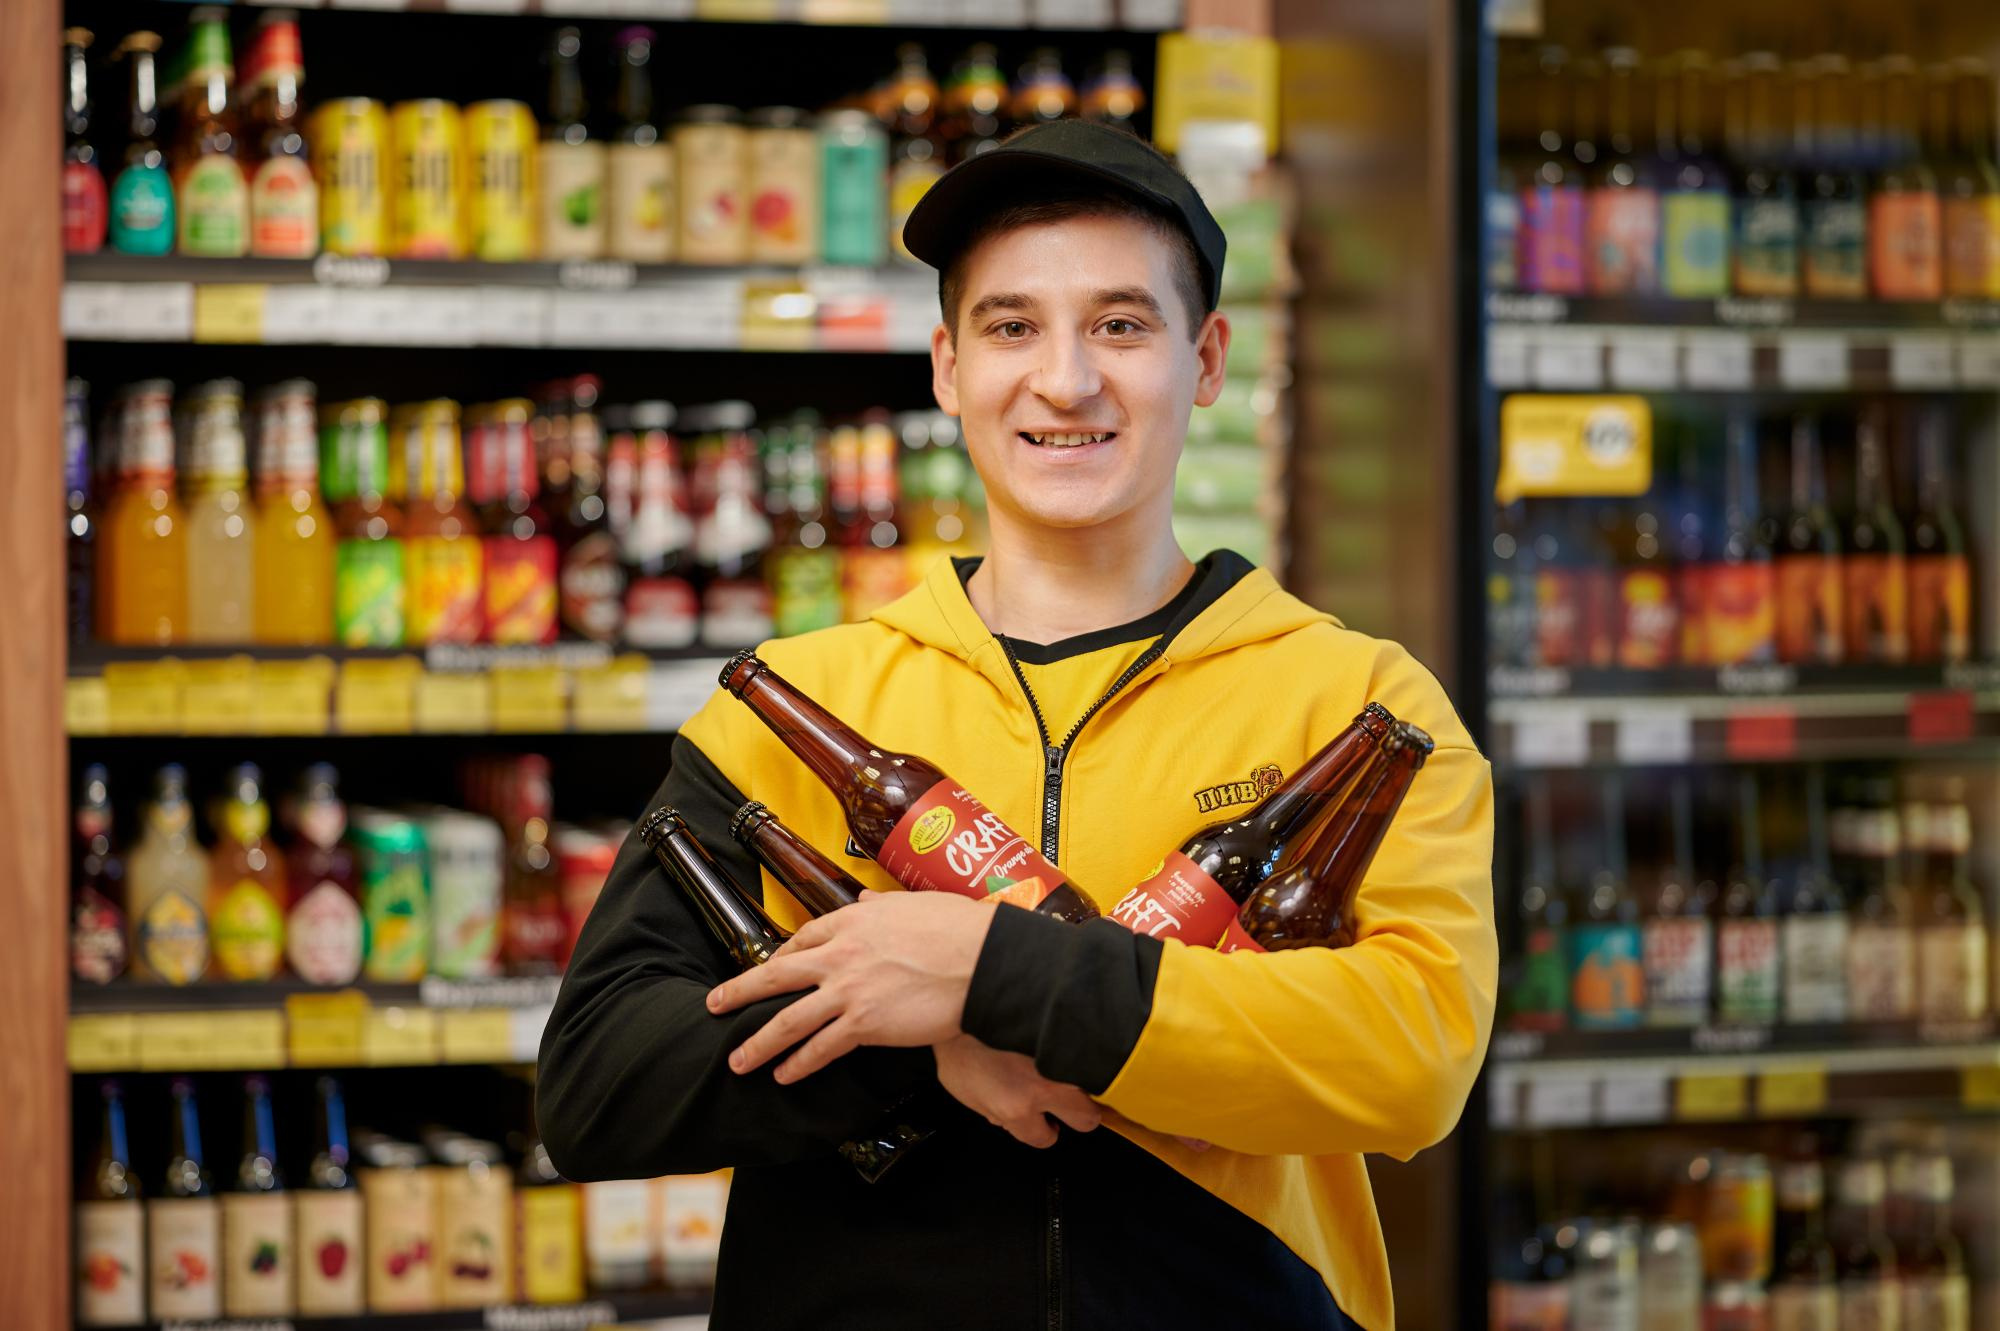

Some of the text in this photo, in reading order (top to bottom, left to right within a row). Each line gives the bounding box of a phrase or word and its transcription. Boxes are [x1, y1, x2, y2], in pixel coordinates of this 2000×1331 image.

[945, 812, 1013, 876] CRAF
[993, 850, 1027, 879] Orange
[1112, 887, 1181, 937] RAFT
